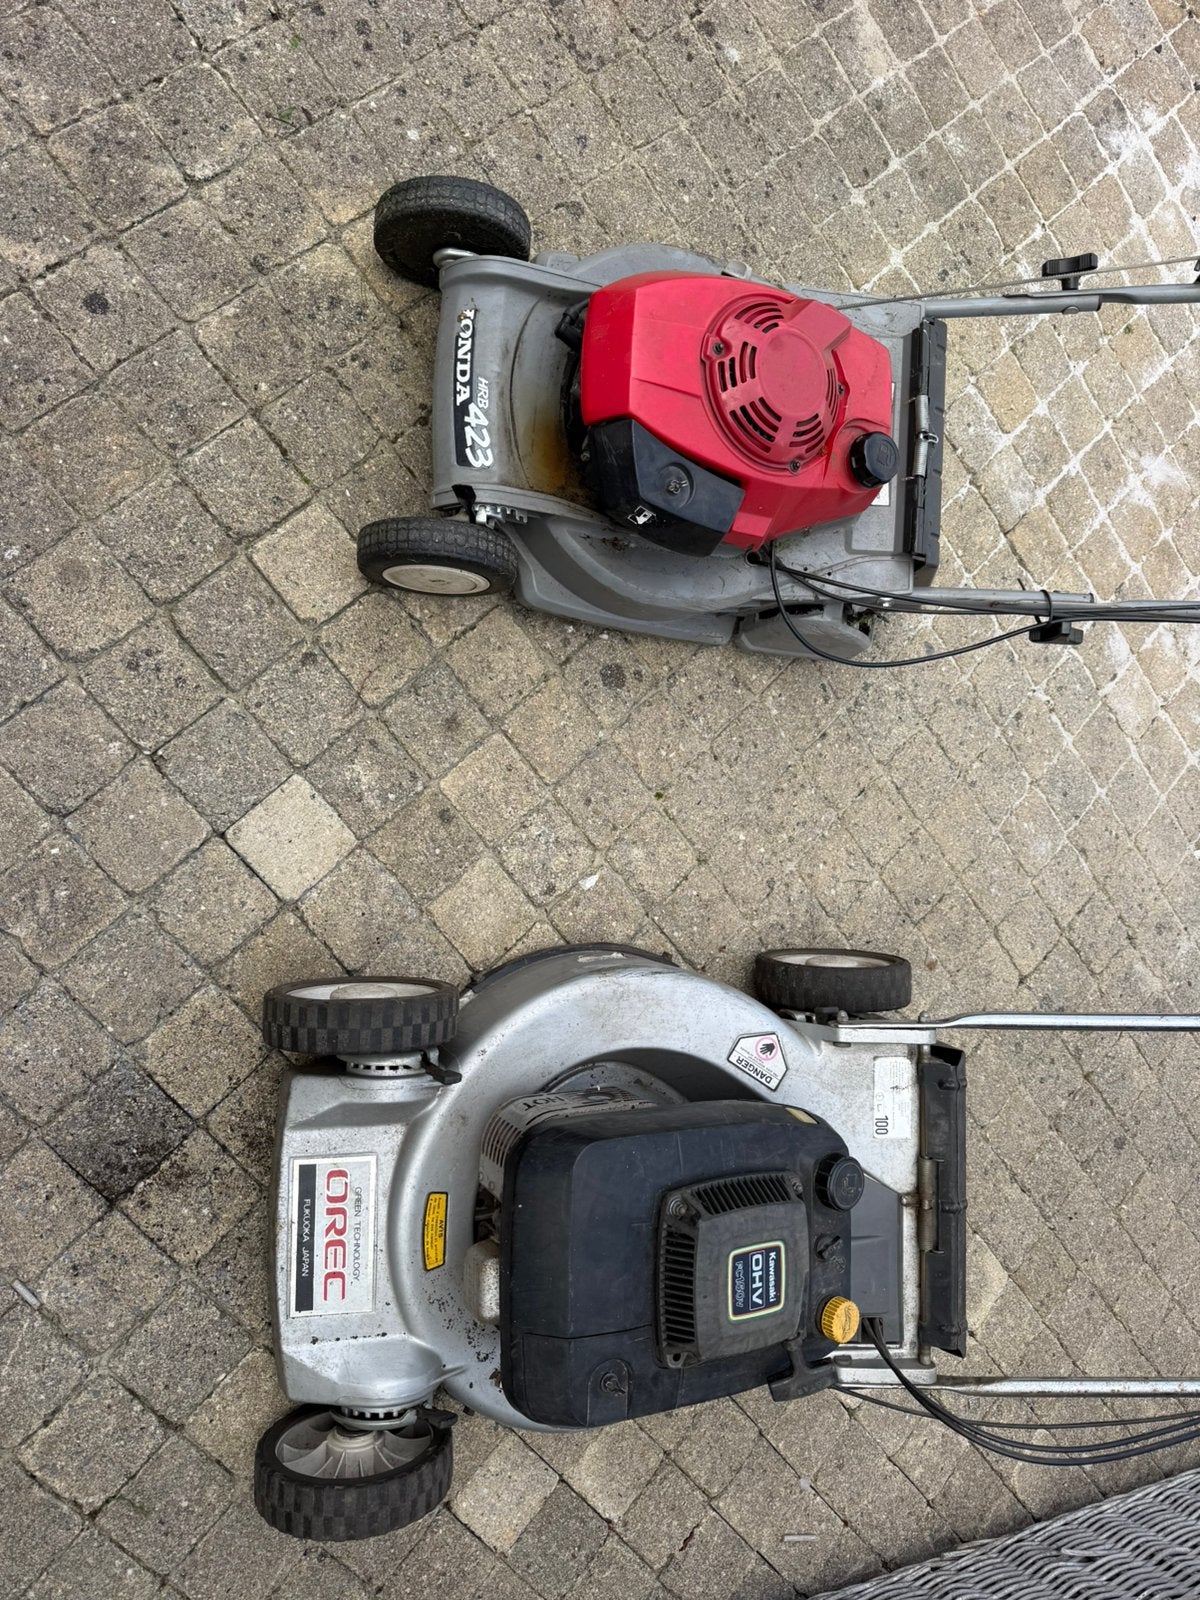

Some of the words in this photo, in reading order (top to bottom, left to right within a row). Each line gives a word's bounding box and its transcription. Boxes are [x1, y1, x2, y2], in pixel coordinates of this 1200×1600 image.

[477, 376, 489, 411] HRB
[464, 402, 495, 469] 423
[736, 1056, 773, 1084] DANGER
[522, 1096, 565, 1111] HOT
[875, 1115, 889, 1135] 100
[302, 1198, 311, 1243] FUKUOKA
[353, 1186, 363, 1217] GREEN
[323, 1168, 350, 1302] OREC
[352, 1222, 362, 1282] TECHNOLOGY
[301, 1246, 311, 1277] JAPAN
[735, 1260, 745, 1308] FC150V
[752, 1253, 763, 1305] OHV
[768, 1251, 777, 1302] Kawasaki
